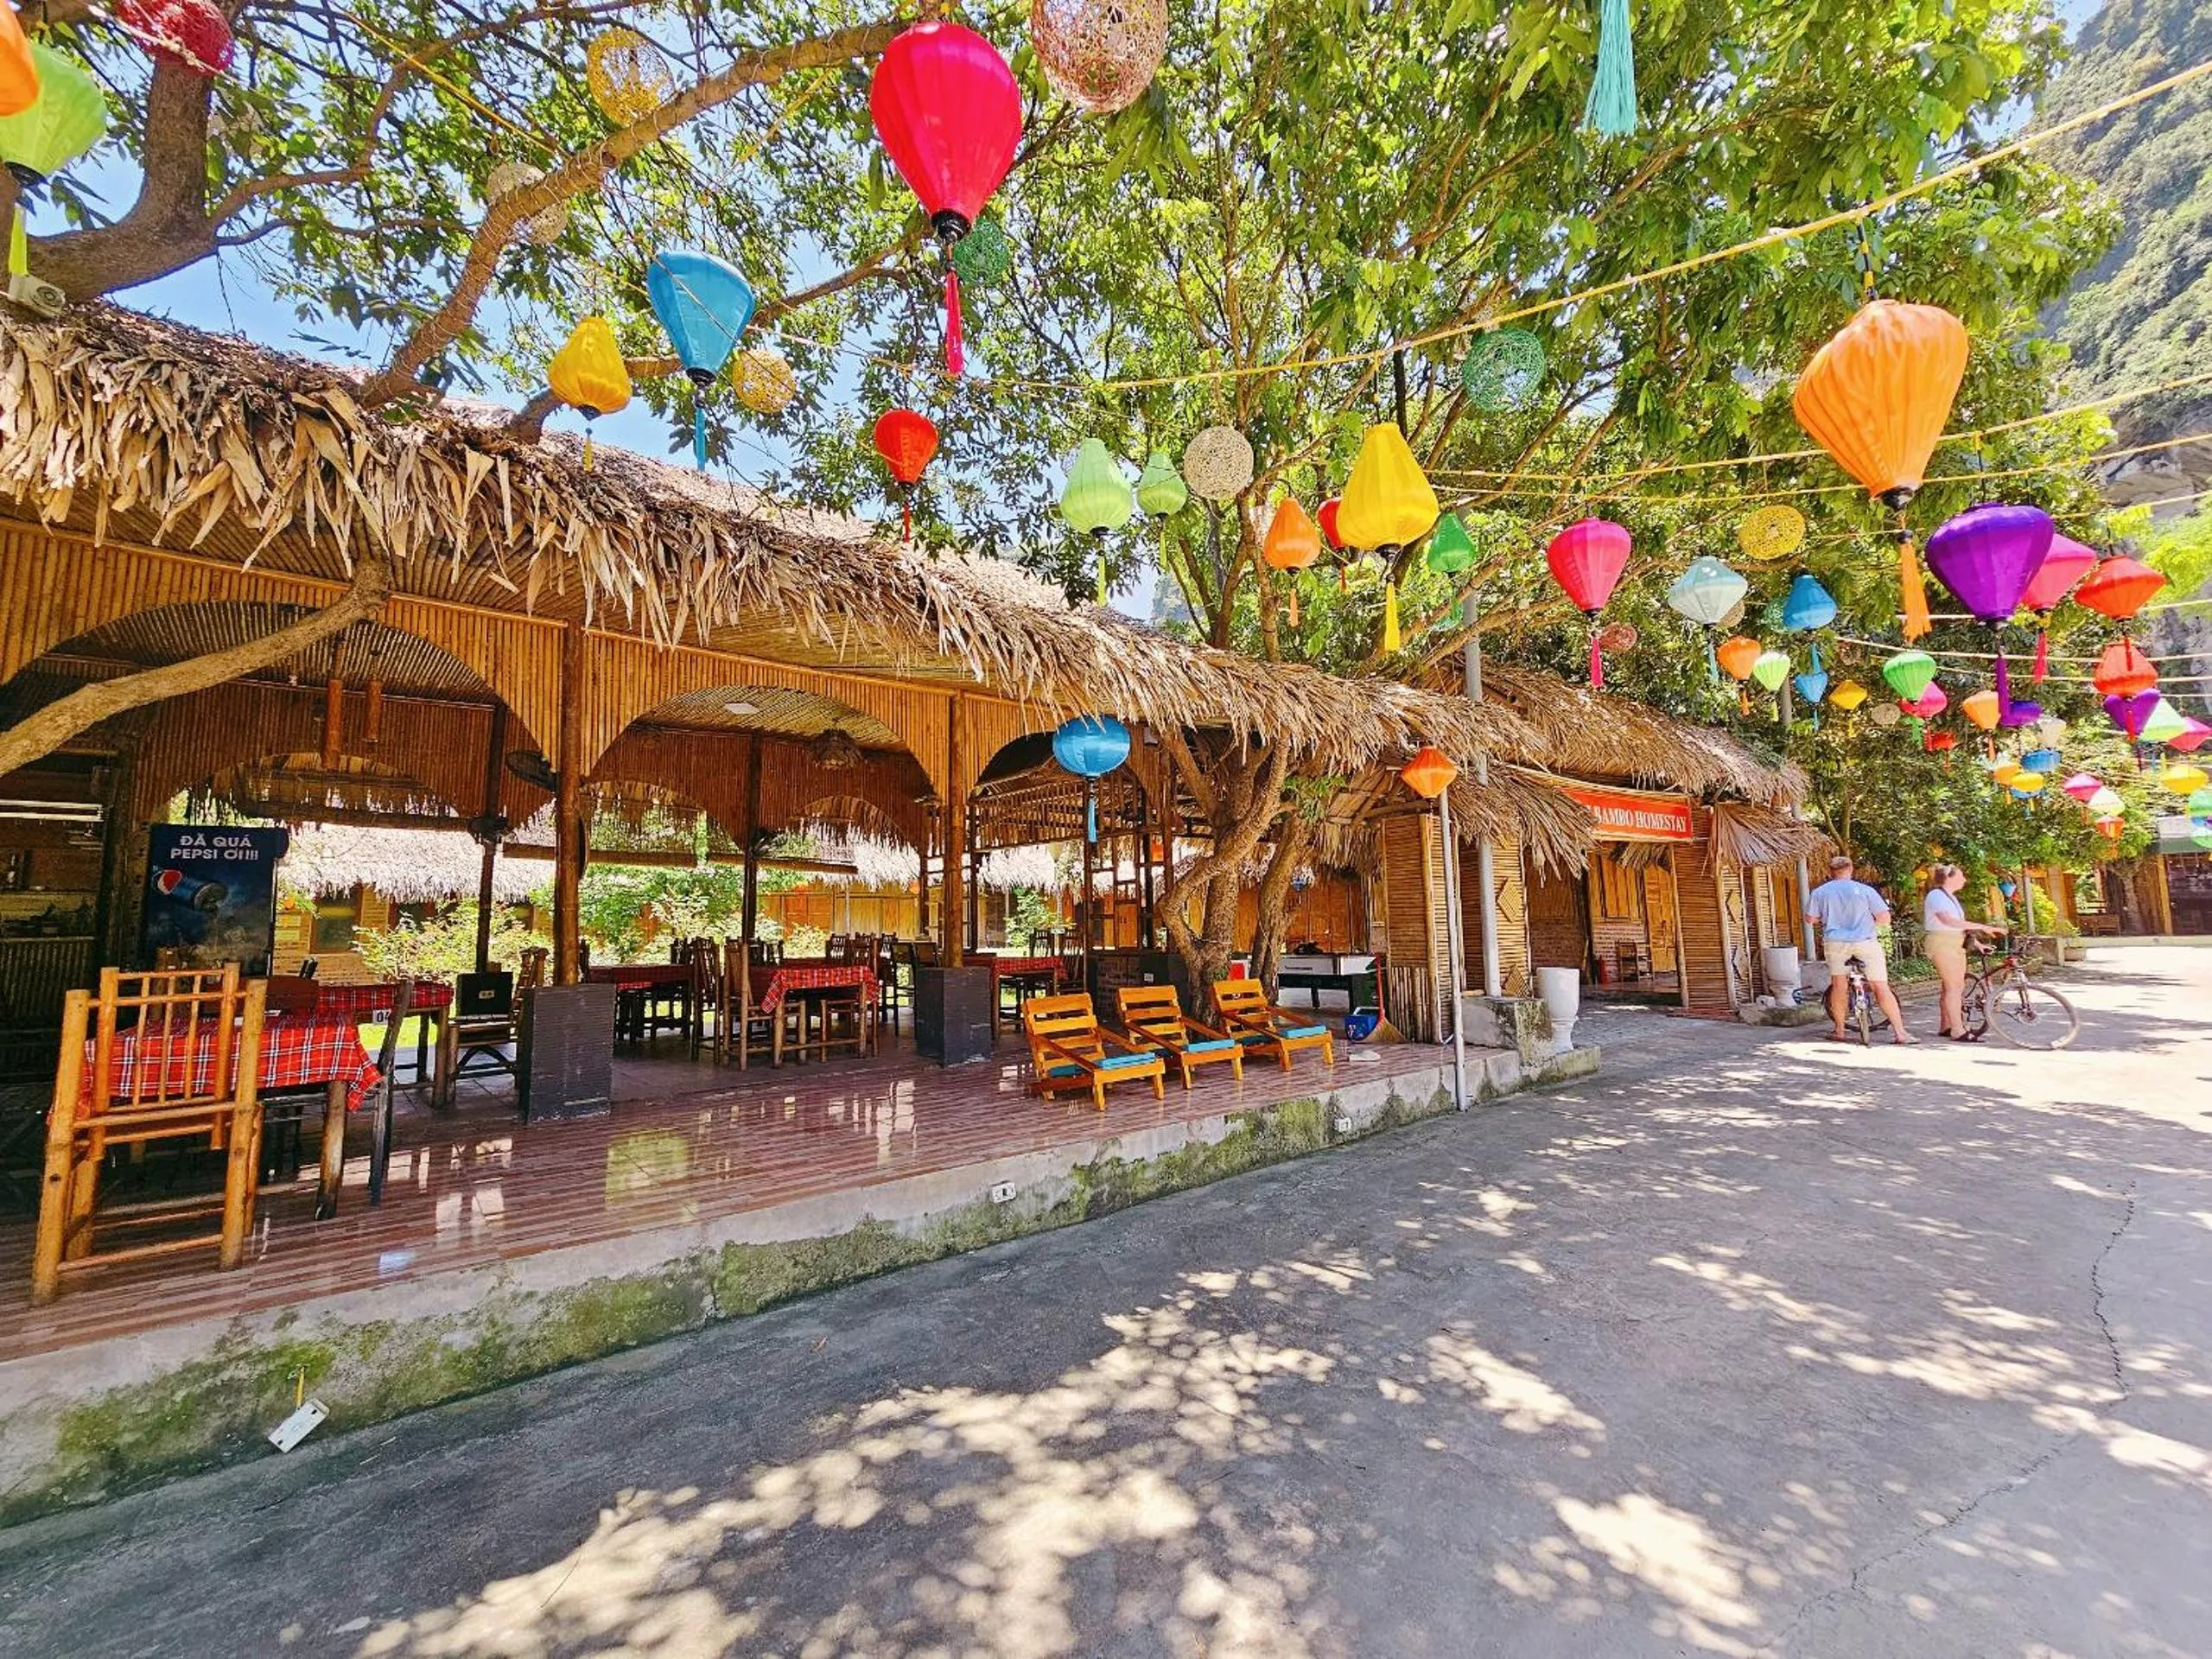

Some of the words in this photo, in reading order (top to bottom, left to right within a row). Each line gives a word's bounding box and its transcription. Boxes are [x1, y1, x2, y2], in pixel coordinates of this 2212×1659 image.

[1635, 810, 1687, 833] HOMESTAY
[213, 834, 251, 847] QUÁ
[170, 848, 218, 860] PEPSI
